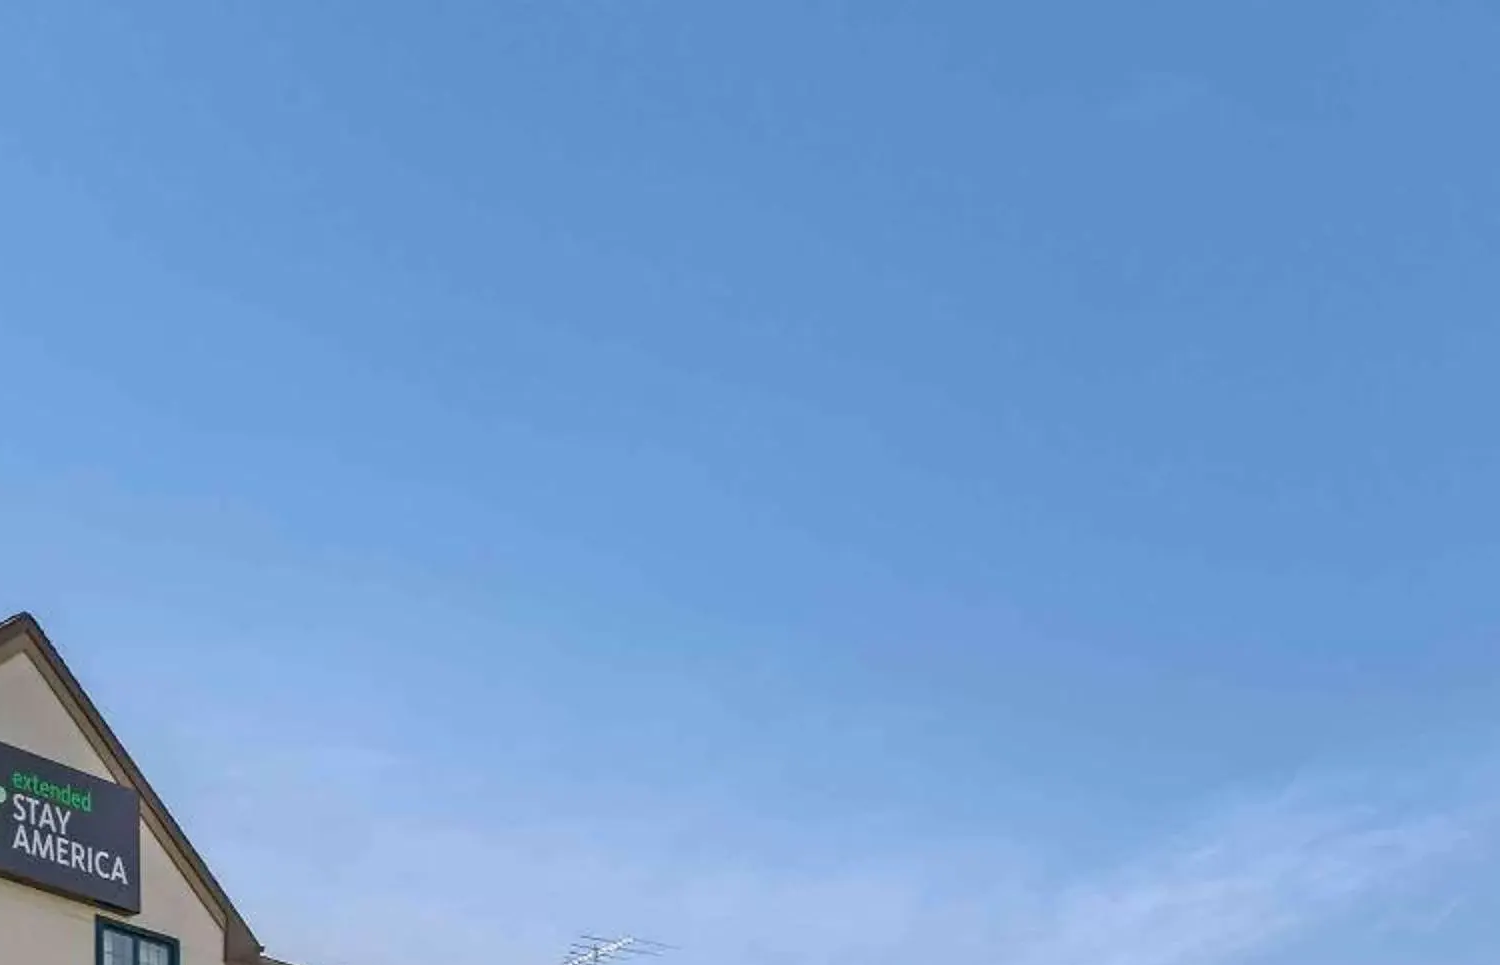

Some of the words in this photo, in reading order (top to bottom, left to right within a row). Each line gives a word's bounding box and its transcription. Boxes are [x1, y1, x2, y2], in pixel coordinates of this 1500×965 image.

[12, 771, 92, 812] extended
[12, 793, 71, 834] STAY
[12, 824, 128, 885] AMERICA
